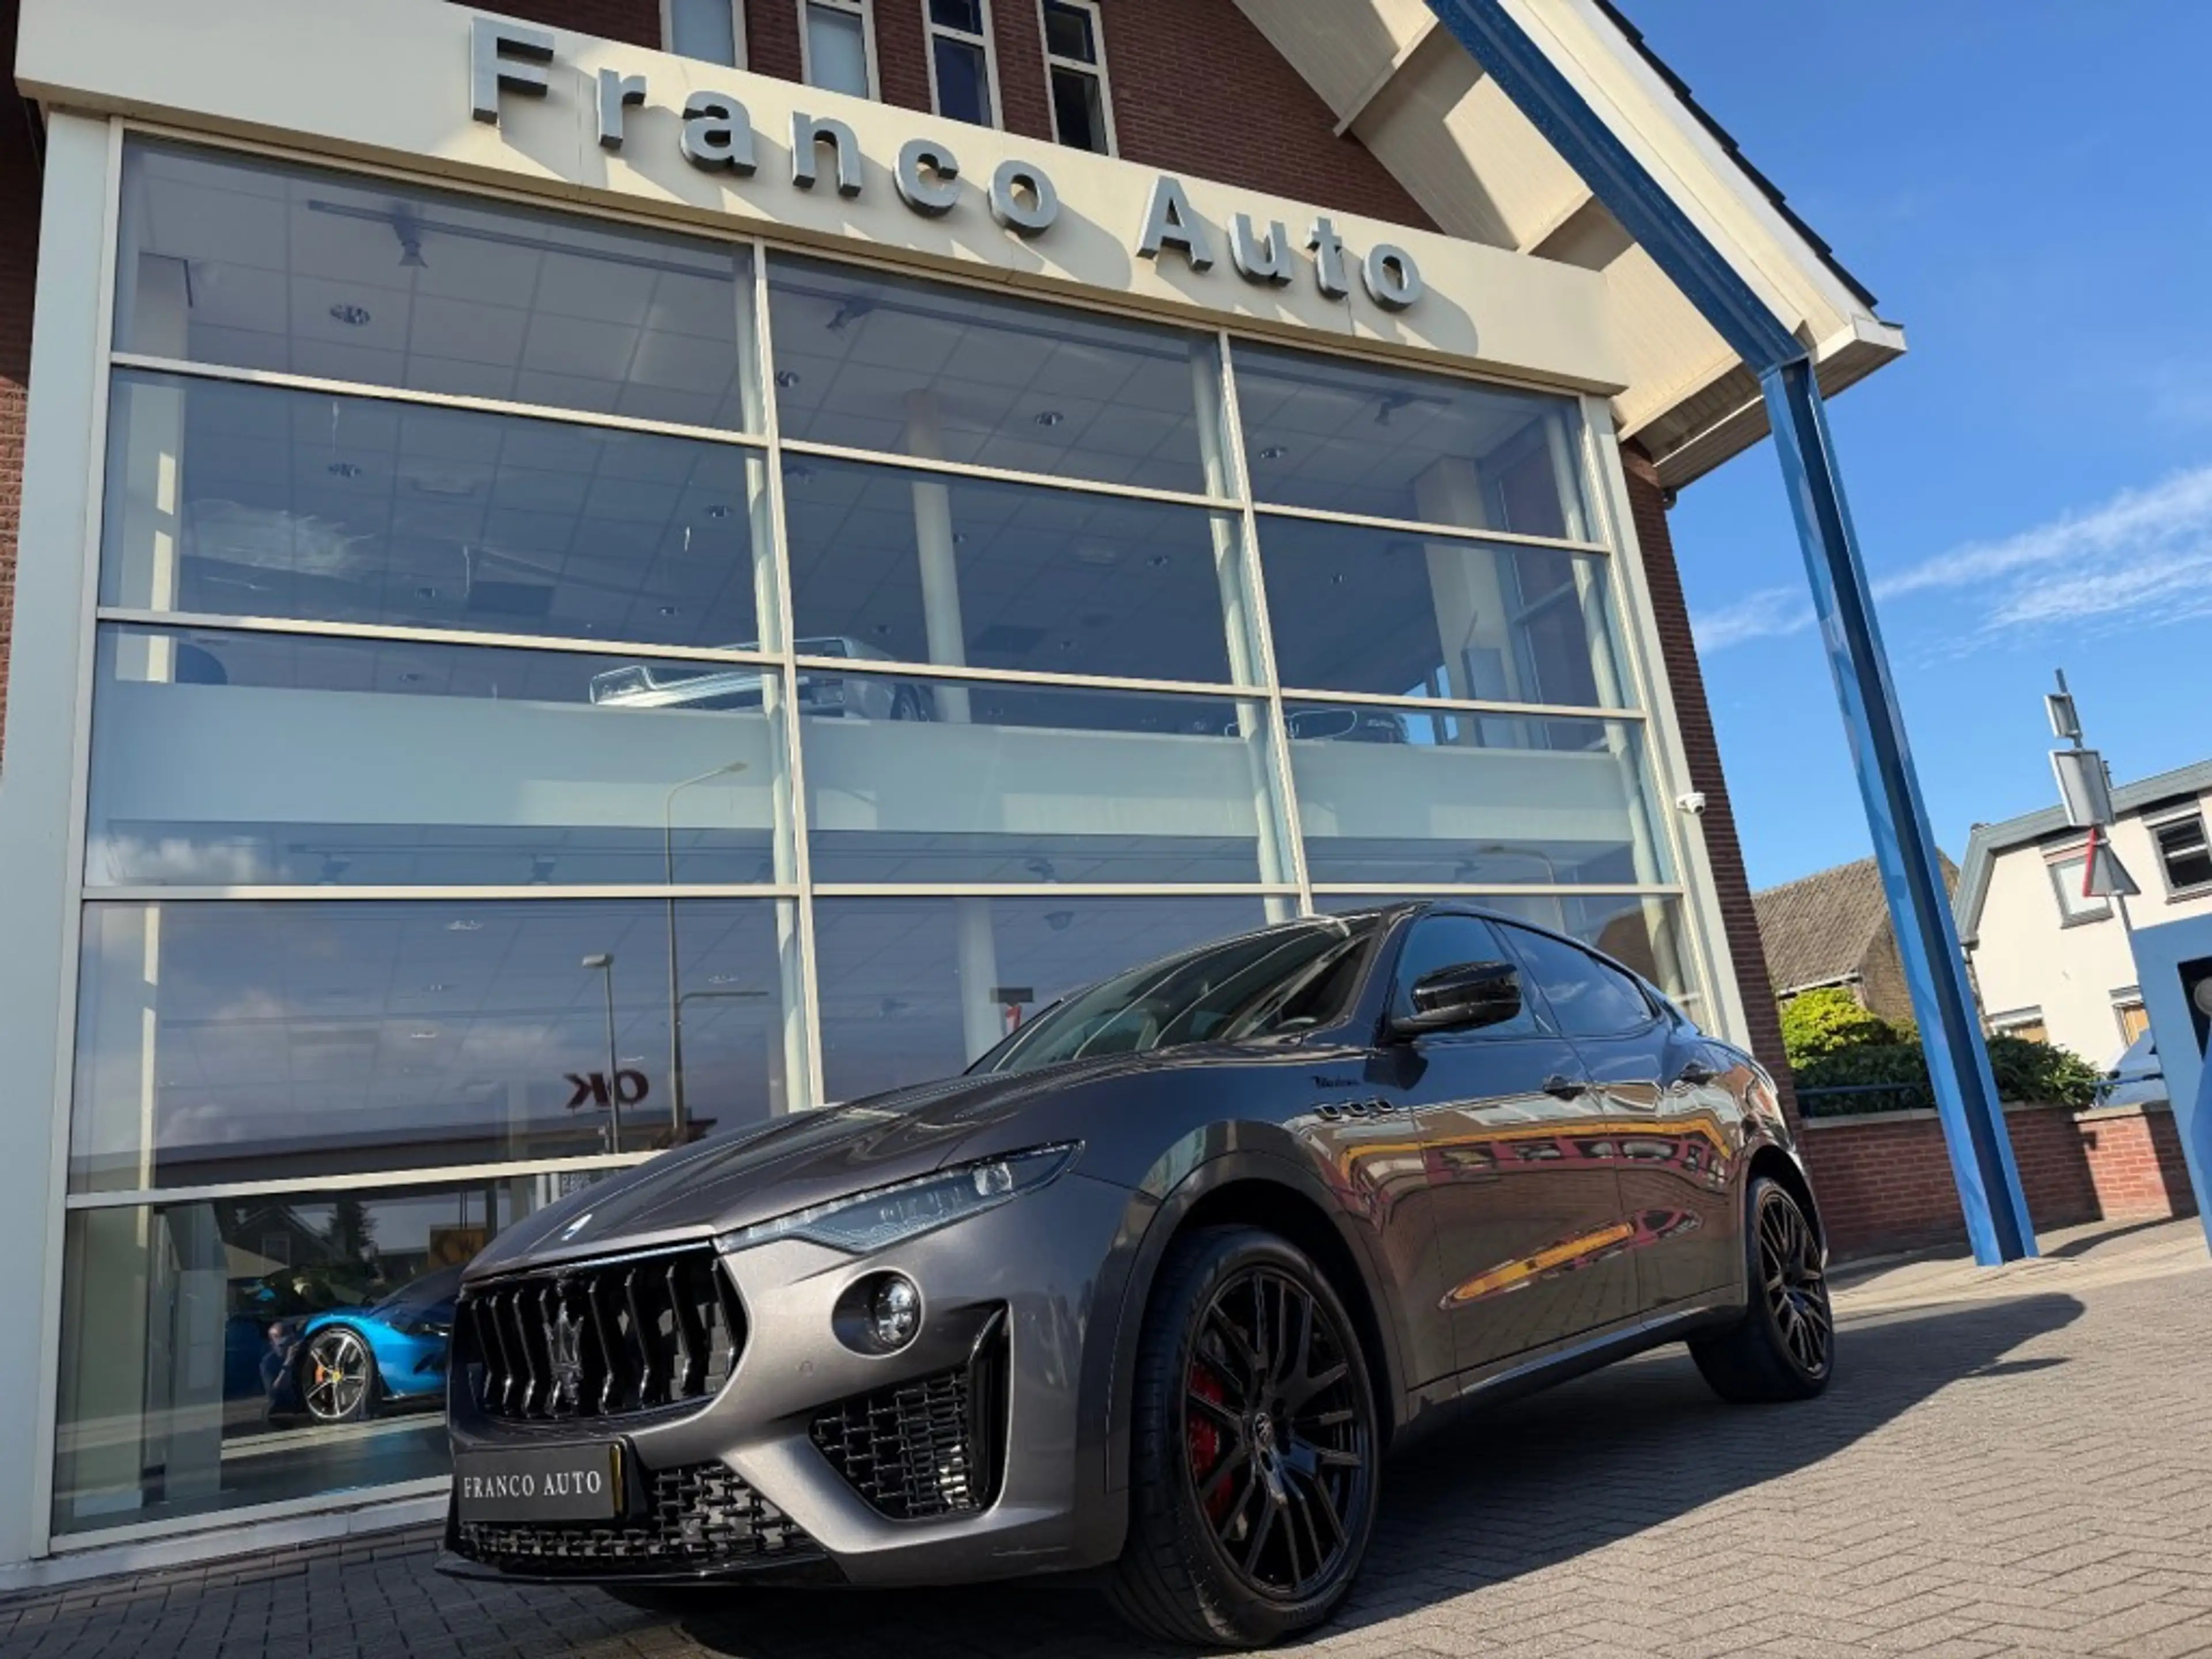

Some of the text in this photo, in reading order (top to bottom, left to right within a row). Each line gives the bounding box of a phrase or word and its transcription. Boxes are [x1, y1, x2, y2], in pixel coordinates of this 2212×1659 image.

[470, 16, 1423, 312] Franco Auto
[463, 1470, 602, 1498] FRANCO AUTO
